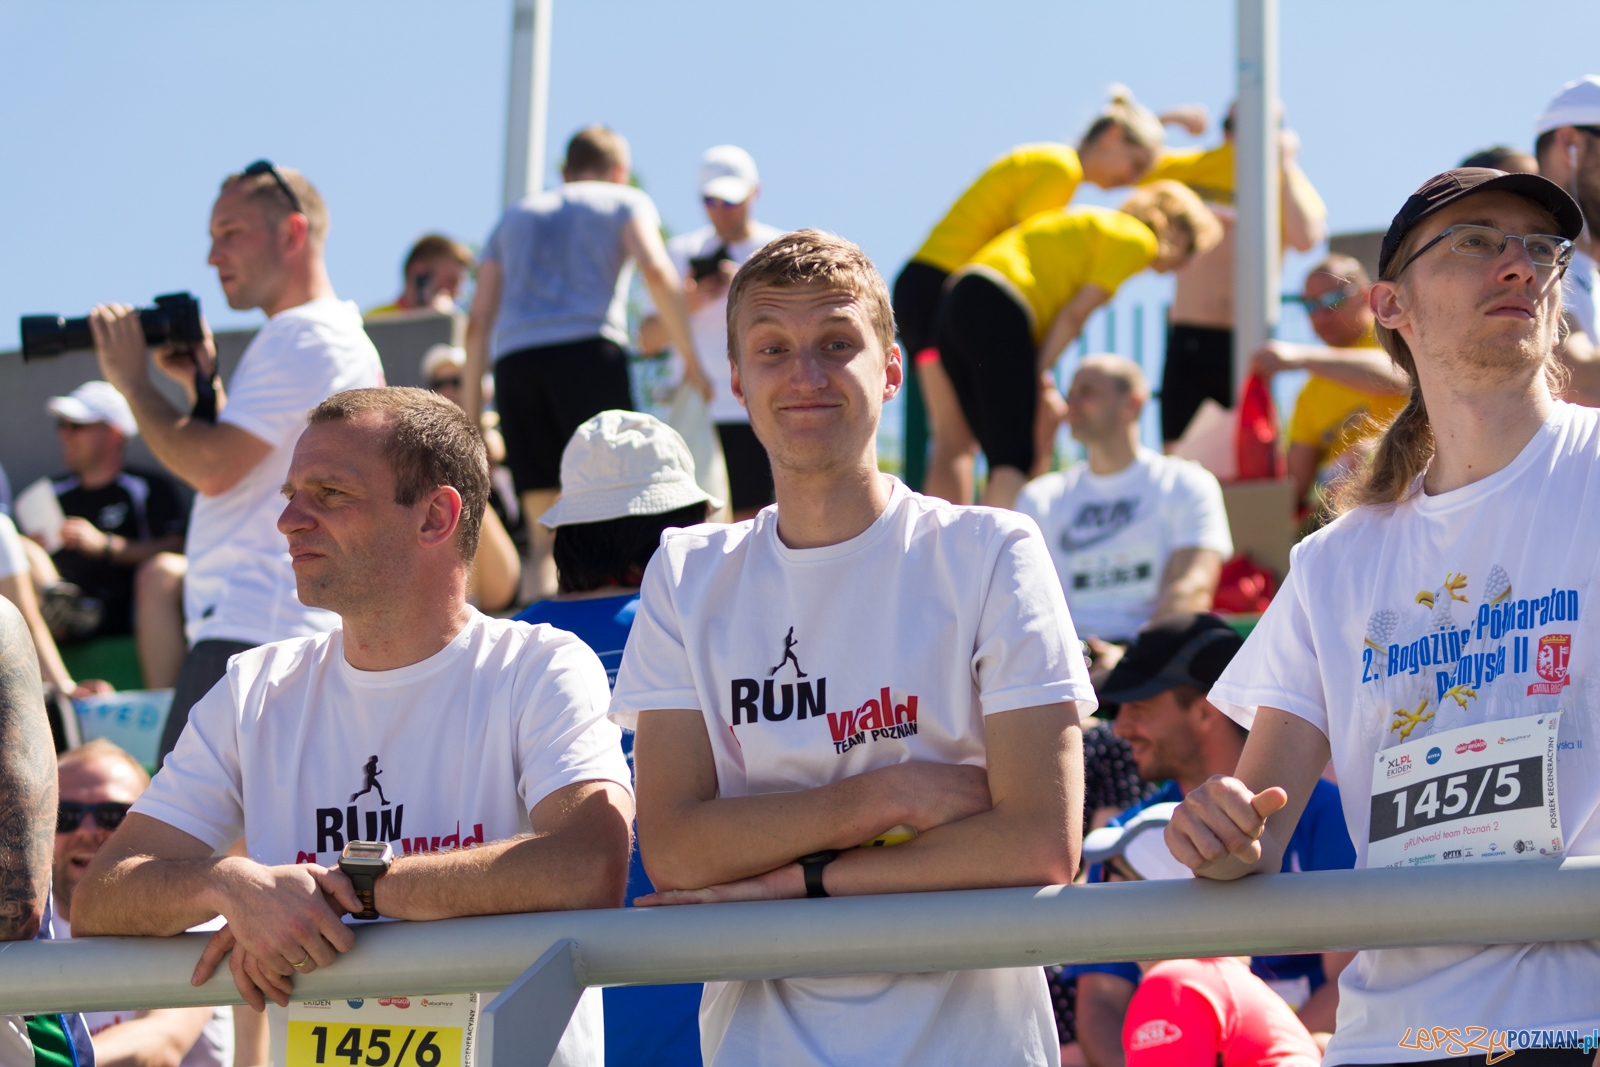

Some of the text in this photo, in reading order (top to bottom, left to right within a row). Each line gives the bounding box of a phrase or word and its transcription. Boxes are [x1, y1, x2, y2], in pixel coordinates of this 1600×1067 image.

[1362, 647, 1379, 684] 2.
[1513, 636, 1528, 674] II
[731, 677, 826, 726] RUN
[1532, 682, 1550, 695] GMINA
[826, 686, 918, 742] wald
[833, 731, 866, 755] TEAM
[1427, 752, 1441, 760] NIVEA
[1387, 754, 1412, 769] XLPL
[1387, 764, 1412, 777] EKIDEN
[1392, 763, 1522, 829] 145/5
[1546, 736, 1558, 829] POSIŁEK REGENERACYJNY
[316, 803, 404, 853] RUN
[1403, 821, 1500, 851] gRUNwald team Poznań 2
[1408, 854, 1437, 866] Schneider
[1442, 849, 1462, 859] OPTYK
[311, 1026, 442, 1067] 145/6
